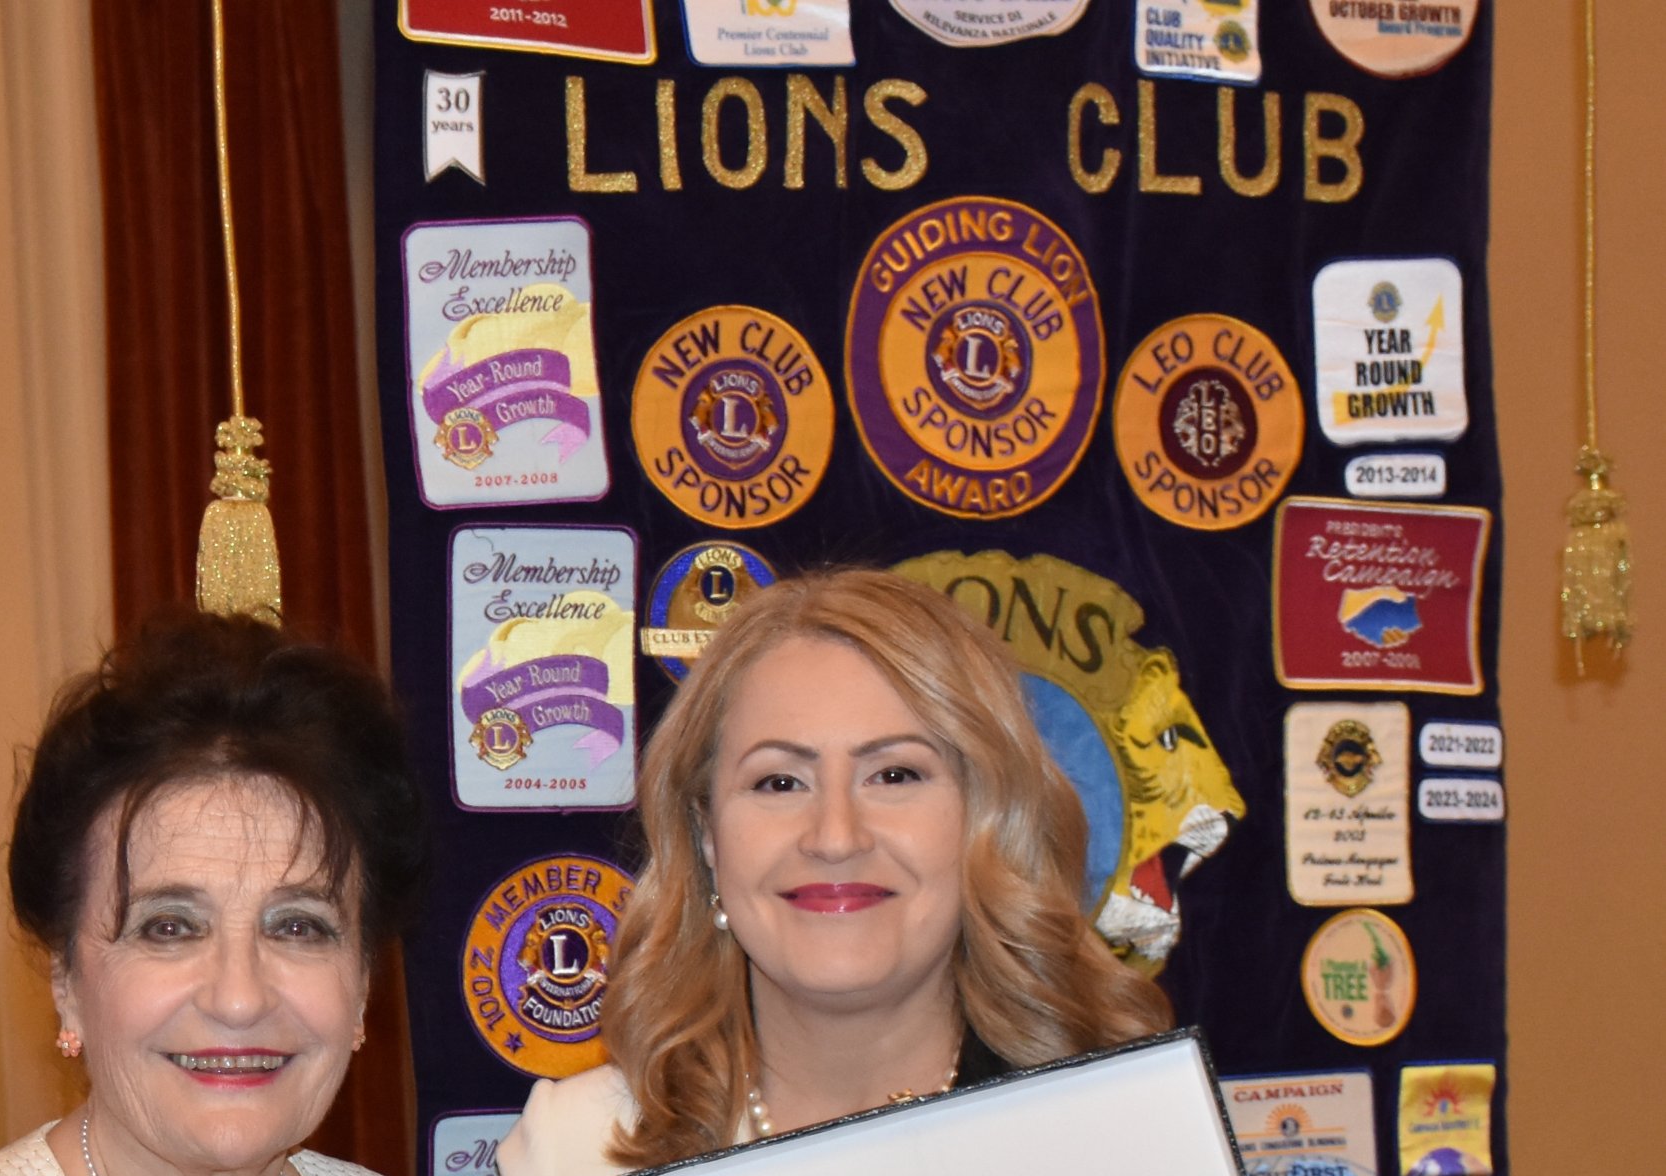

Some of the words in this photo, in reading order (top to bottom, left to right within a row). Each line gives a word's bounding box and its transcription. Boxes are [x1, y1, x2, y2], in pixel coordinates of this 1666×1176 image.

[490, 7, 568, 28] 2011-2012
[953, 10, 1005, 25] SERVICE
[1146, 7, 1181, 27] CLUB
[1329, 0, 1395, 21] OCTOBER
[1398, 1, 1461, 24] GROWTH
[718, 28, 762, 41] Premier
[766, 28, 830, 41] Centennial
[1146, 28, 1204, 51] QUALITY
[744, 44, 780, 56] Lions
[783, 44, 808, 57] Club
[1145, 49, 1223, 71] INITIATIVE
[436, 87, 470, 112] 30
[431, 119, 474, 133] years
[565, 74, 929, 192] LIONS
[1067, 79, 1366, 203] CLUB
[419, 249, 577, 283] Membership
[871, 207, 1015, 294] GUIDING
[1020, 223, 1091, 309] LION
[442, 286, 564, 322] Excellence
[899, 265, 968, 333] NEW
[986, 267, 1065, 341] CLUB
[956, 311, 1005, 336] LIONS
[1364, 328, 1412, 354] YEAR
[652, 320, 720, 390] NEW
[739, 319, 814, 396] CLUB
[965, 336, 991, 379] L
[1132, 331, 1194, 394] LEO
[1212, 328, 1285, 401] CLUB
[710, 374, 760, 394] LIONS
[1355, 360, 1423, 386] ROUND
[495, 394, 557, 424] Growth
[719, 397, 750, 438] L
[1200, 380, 1218, 454] LEO
[1346, 390, 1436, 419] GROWTH
[902, 386, 1057, 460] SPONSOR
[474, 473, 558, 487] 2007-2008
[654, 446, 811, 519] SPONSOR
[903, 457, 1034, 512] AWARD
[1133, 450, 1282, 520] SPONSOR
[1355, 465, 1437, 484] 2013-2014
[698, 550, 739, 570] LIONS
[1305, 535, 1440, 566] Retention
[462, 552, 621, 591] Membership
[709, 571, 728, 599] L
[1323, 559, 1461, 599] Campaign
[484, 589, 606, 623] Excellence
[944, 575, 1116, 674] ONS
[652, 632, 690, 645] CLUB
[528, 660, 582, 687] Round
[484, 708, 519, 725] LIONS
[531, 700, 591, 727] Growth
[1428, 734, 1496, 754] 2021-2022
[504, 778, 587, 791] 2004-2005
[1425, 790, 1498, 809] 2023-2024
[485, 865, 602, 933] MEMBER
[539, 908, 591, 930] LIONS
[549, 934, 580, 975] L
[1321, 973, 1369, 1001] TREE
[523, 990, 604, 1028] FOUNDATIO
[1234, 1083, 1345, 1102] CAMPAIGN
